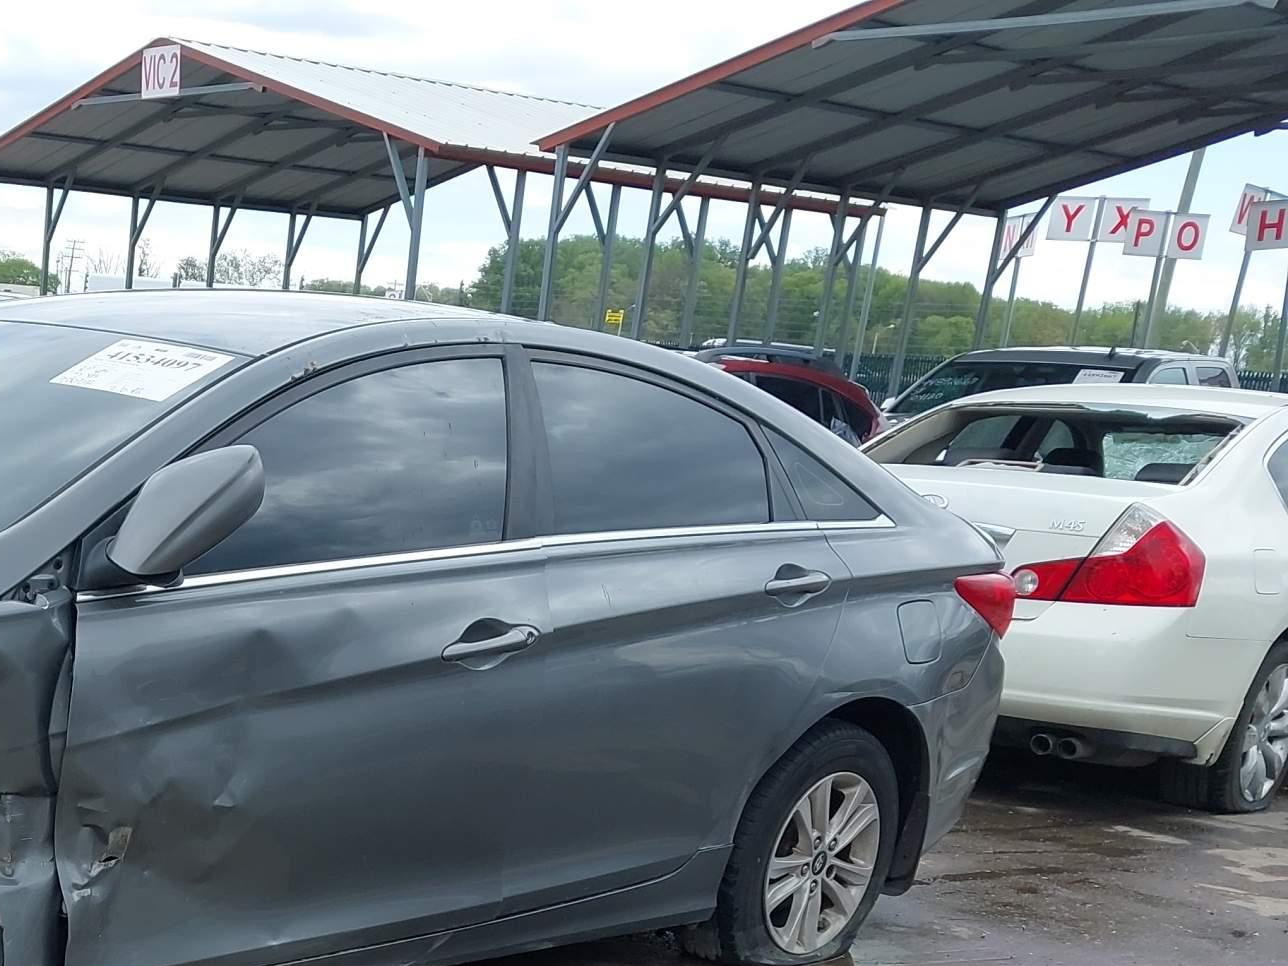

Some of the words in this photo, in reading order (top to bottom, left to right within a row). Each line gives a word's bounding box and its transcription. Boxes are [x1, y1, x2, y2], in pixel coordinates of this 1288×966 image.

[144, 54, 166, 91] VIC
[170, 52, 179, 88] 2
[1062, 204, 1086, 233] Y
[1133, 218, 1155, 248] P
[1176, 221, 1200, 252] O
[1256, 208, 1287, 242] H
[106, 350, 204, 372] 41534097
